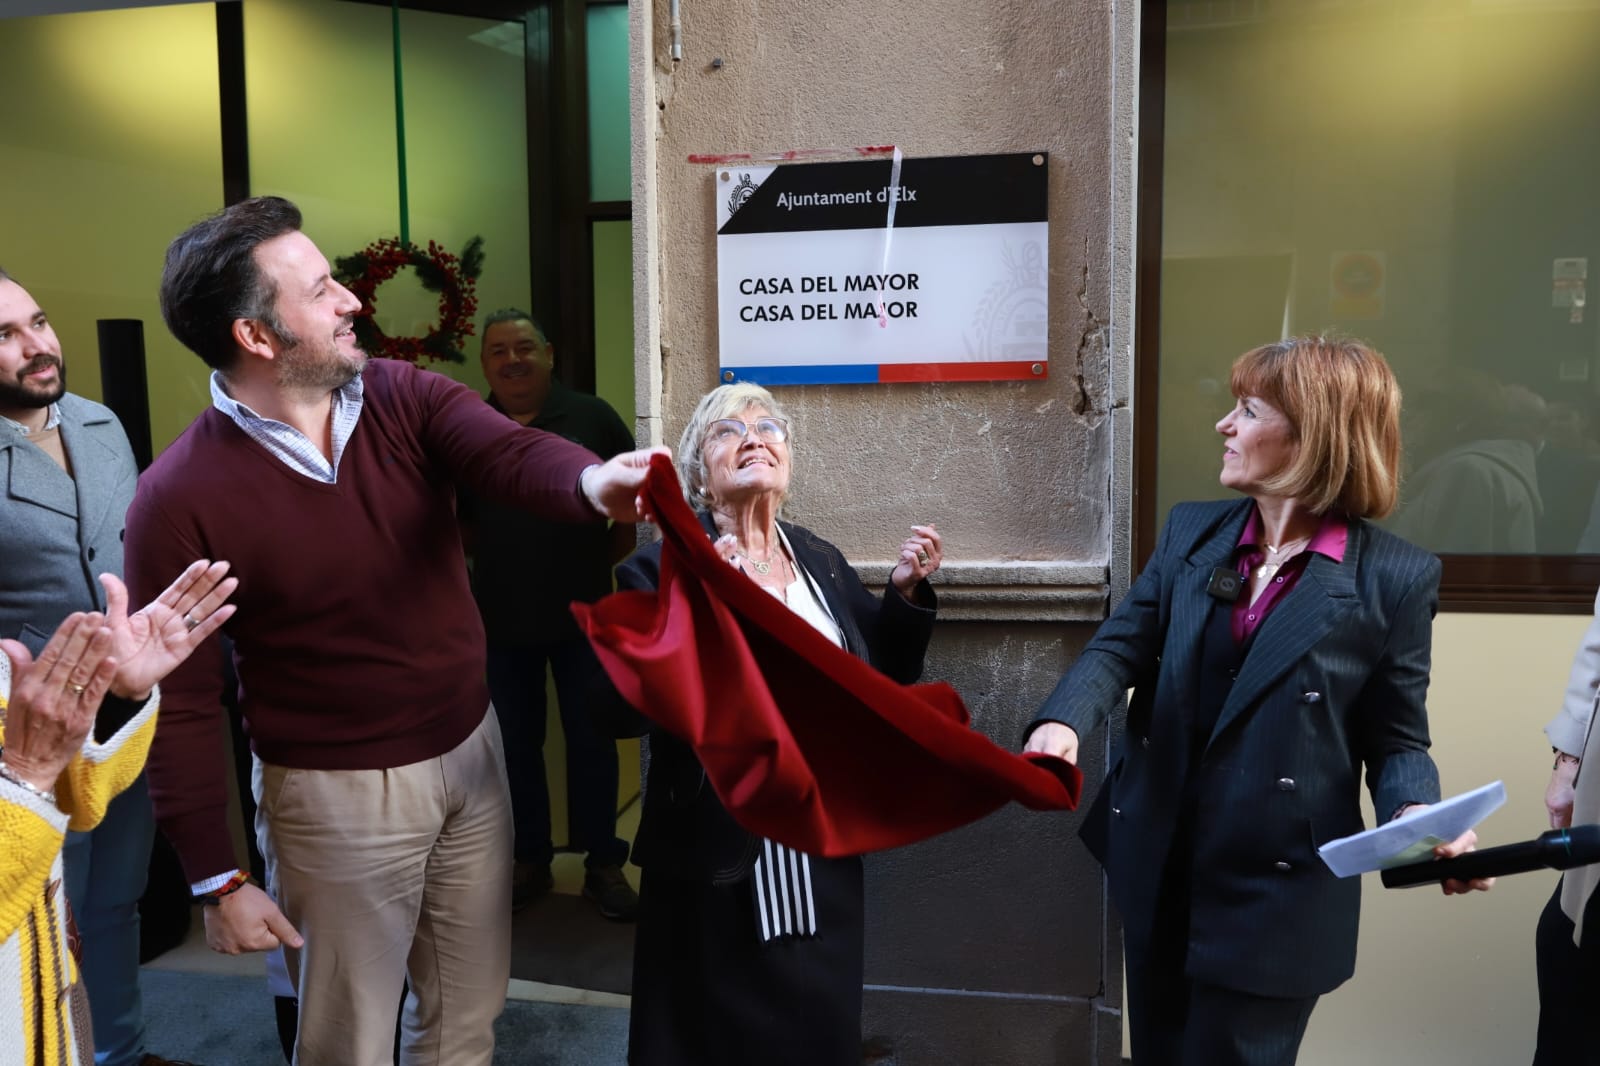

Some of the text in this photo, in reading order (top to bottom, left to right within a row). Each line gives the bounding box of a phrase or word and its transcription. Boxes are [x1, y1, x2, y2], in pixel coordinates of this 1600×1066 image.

[776, 190, 872, 211] Ajuntament
[739, 273, 920, 295] CASA DEL MAYOR
[739, 305, 795, 322] CASA
[800, 304, 838, 320] DEL
